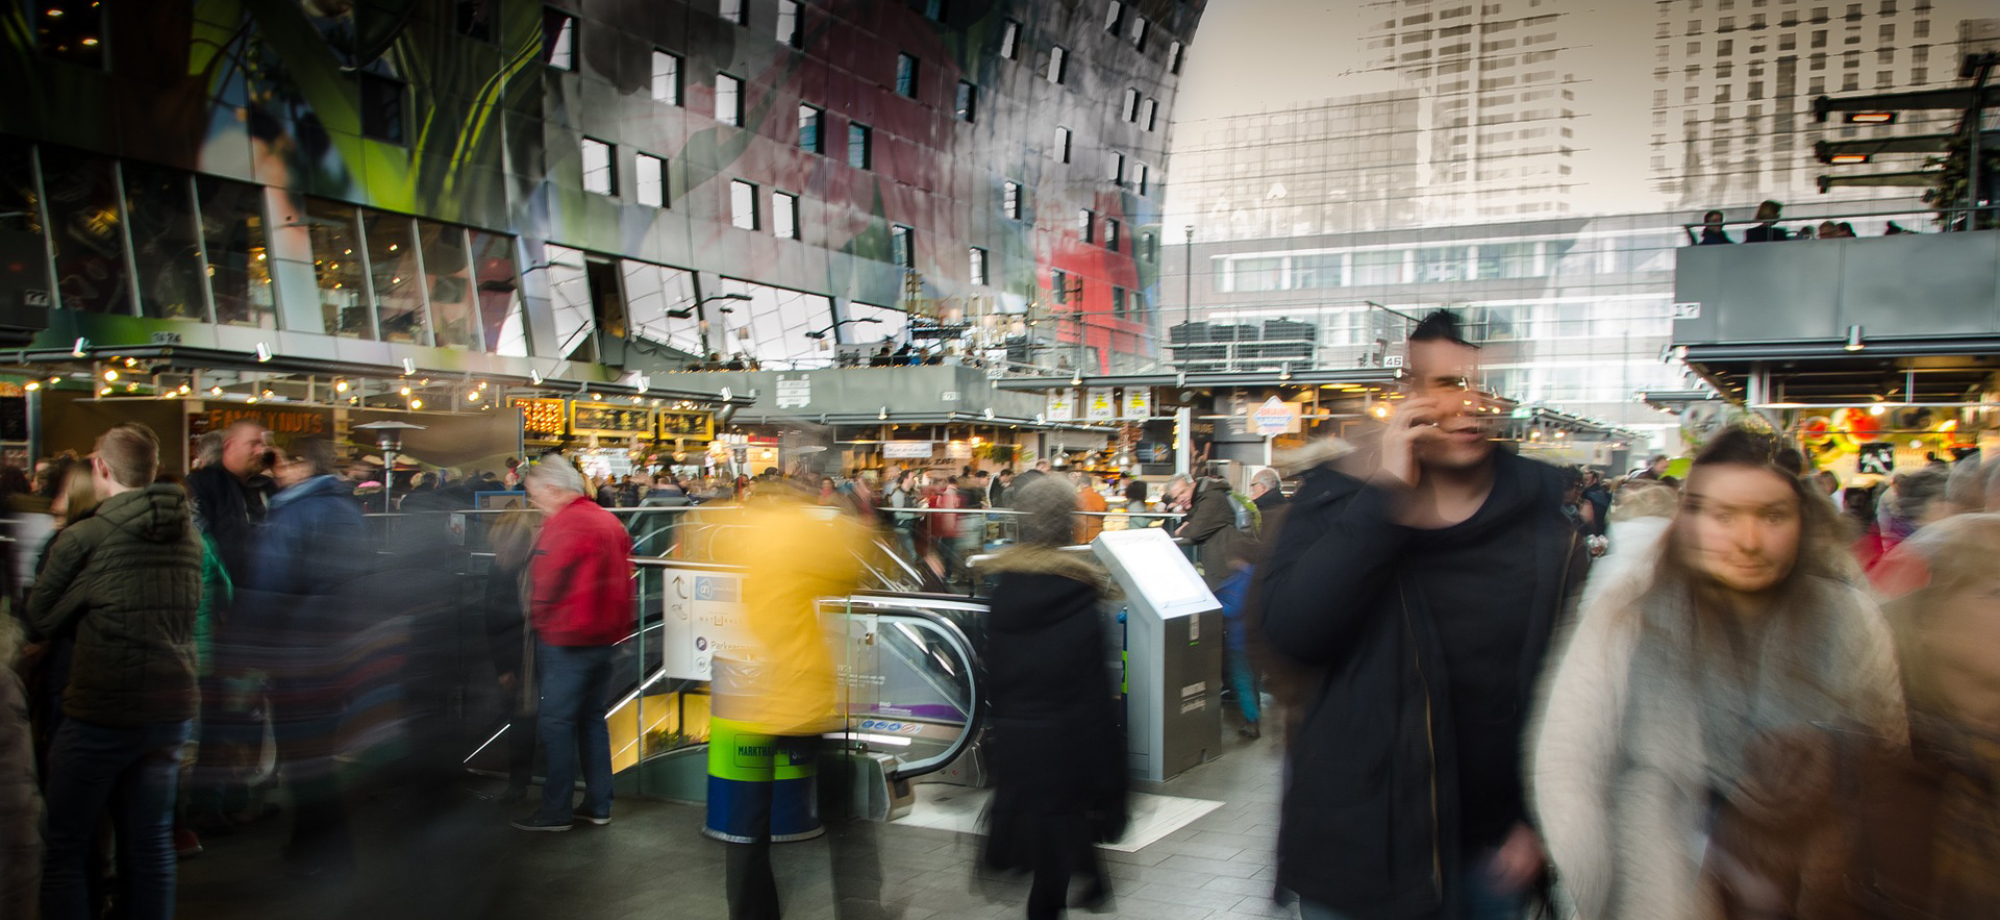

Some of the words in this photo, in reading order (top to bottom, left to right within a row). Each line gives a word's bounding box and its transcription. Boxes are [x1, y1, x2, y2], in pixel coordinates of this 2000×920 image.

[1386, 357, 1401, 366] 46
[209, 408, 276, 431] FAMY
[279, 412, 324, 434] NUTS
